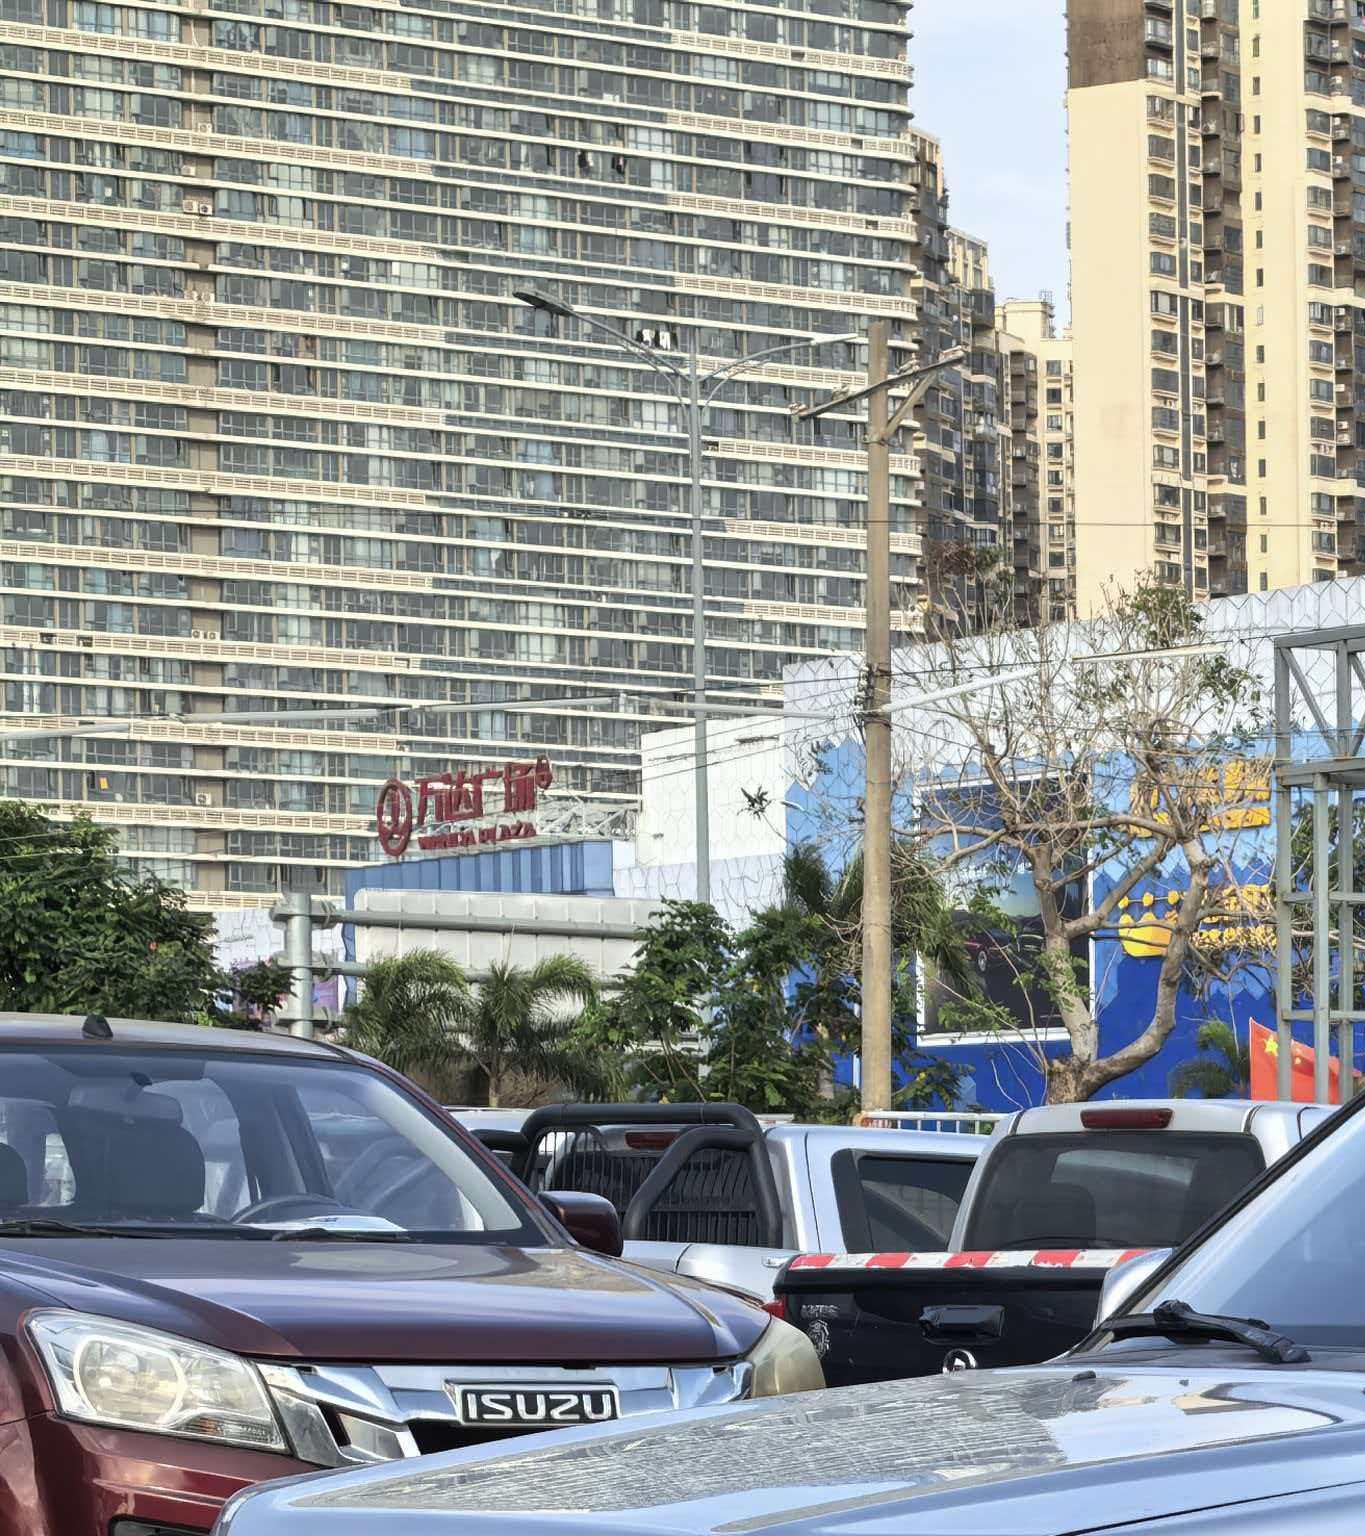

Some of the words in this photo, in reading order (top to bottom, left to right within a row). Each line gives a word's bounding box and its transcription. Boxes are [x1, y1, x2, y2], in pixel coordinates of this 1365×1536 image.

[414, 762, 536, 826] 万达广场
[466, 1393, 612, 1420] ISUZU
